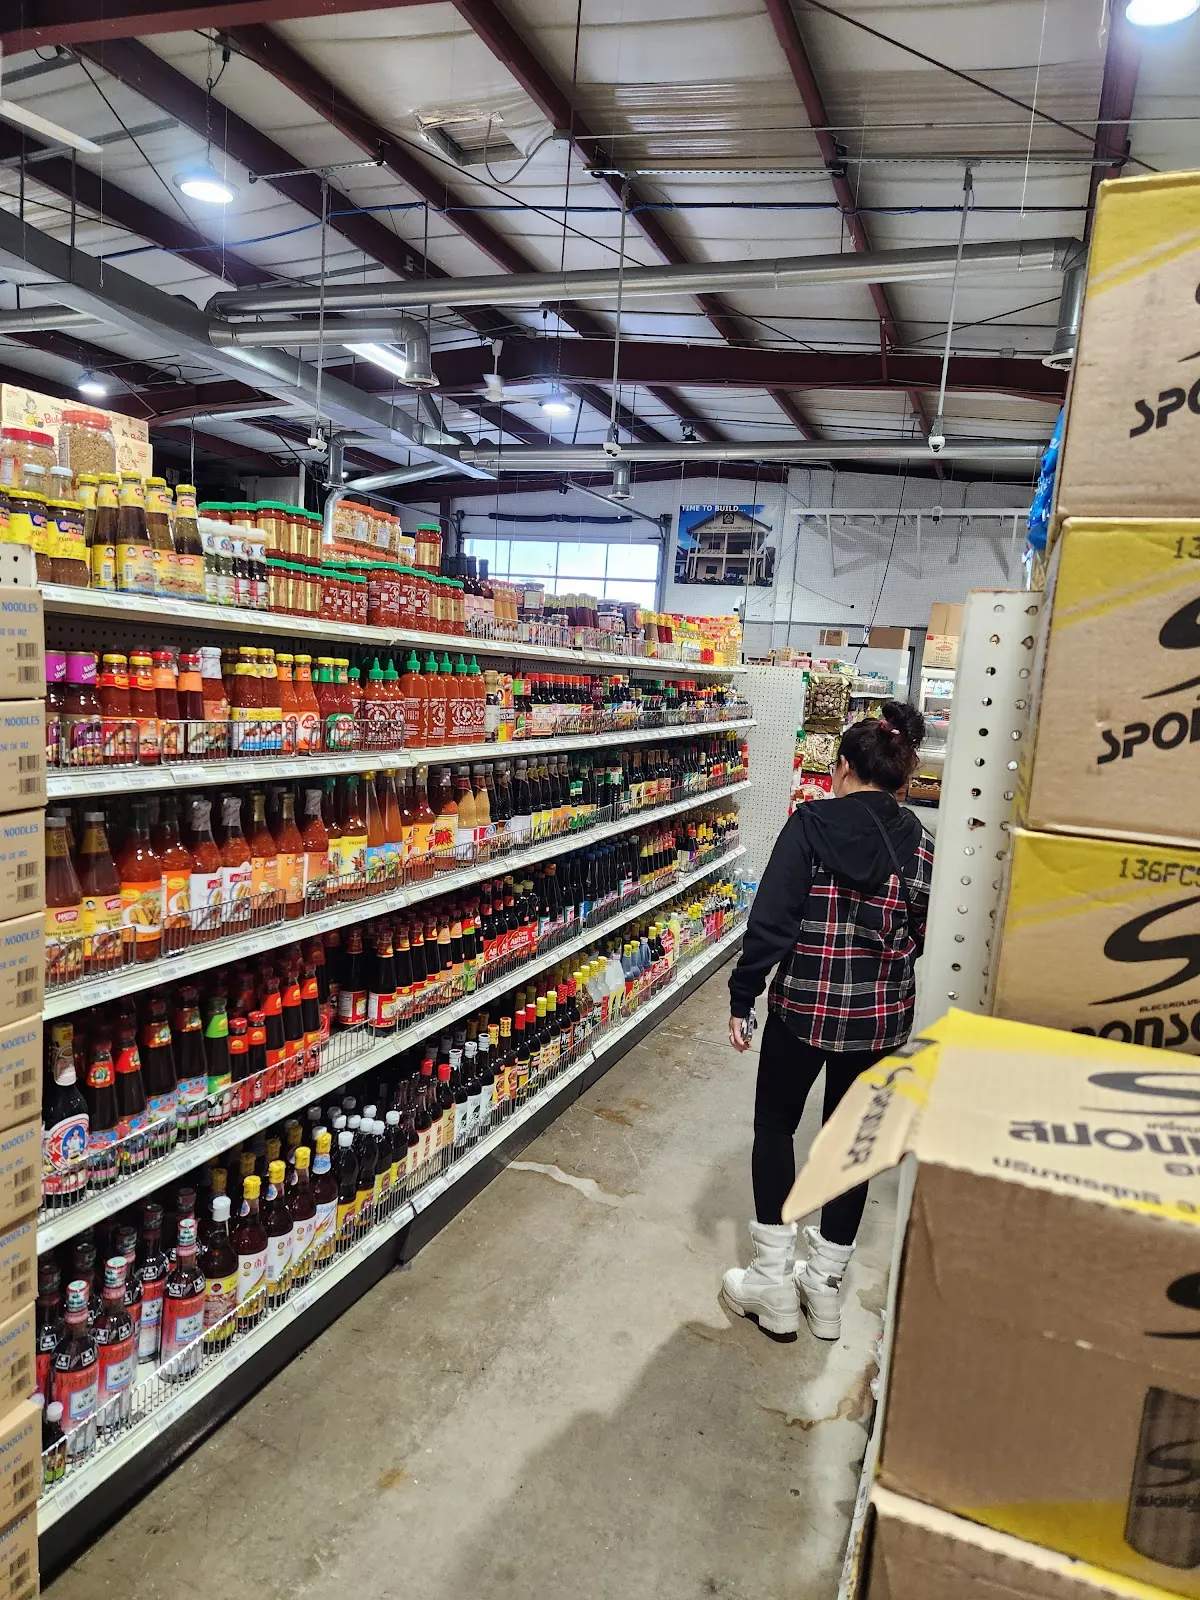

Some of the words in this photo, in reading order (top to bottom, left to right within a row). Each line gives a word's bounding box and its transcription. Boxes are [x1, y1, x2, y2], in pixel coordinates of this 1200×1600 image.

[681, 504, 700, 512] TIME
[702, 504, 713, 512] TO
[2, 601, 38, 613] NOODLES
[5, 715, 40, 727] NOODLES
[3, 823, 39, 838] NOODLES
[1119, 858, 1200, 887] 136FC
[5, 929, 41, 946] NOODLES
